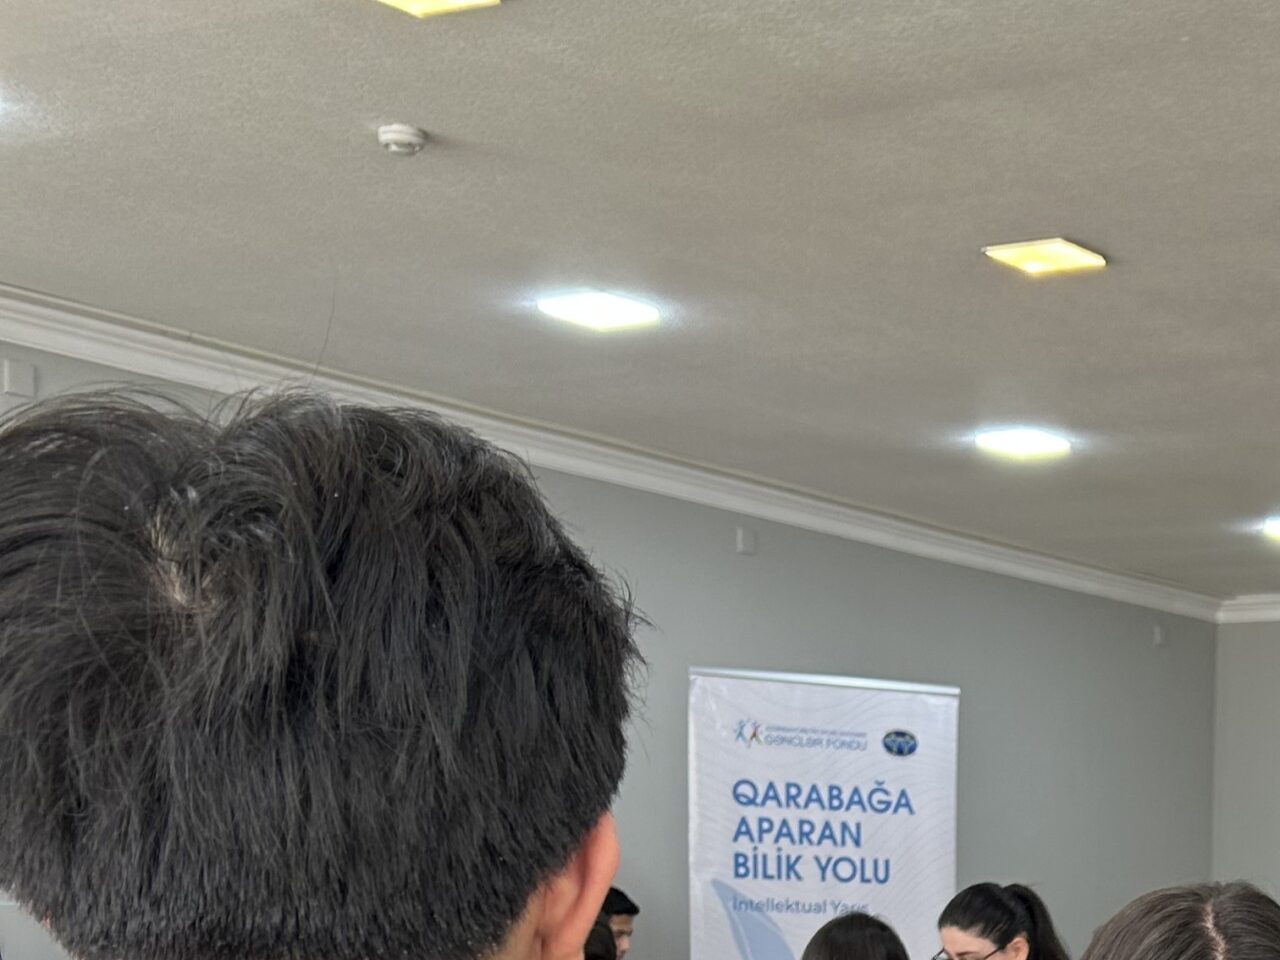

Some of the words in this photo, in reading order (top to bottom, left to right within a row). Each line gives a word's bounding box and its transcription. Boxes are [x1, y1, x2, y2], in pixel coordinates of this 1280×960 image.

[732, 779, 915, 815] QARABAĞA
[732, 816, 862, 848] APARAN
[734, 846, 803, 882] BİLİK
[813, 856, 891, 884] YOLU
